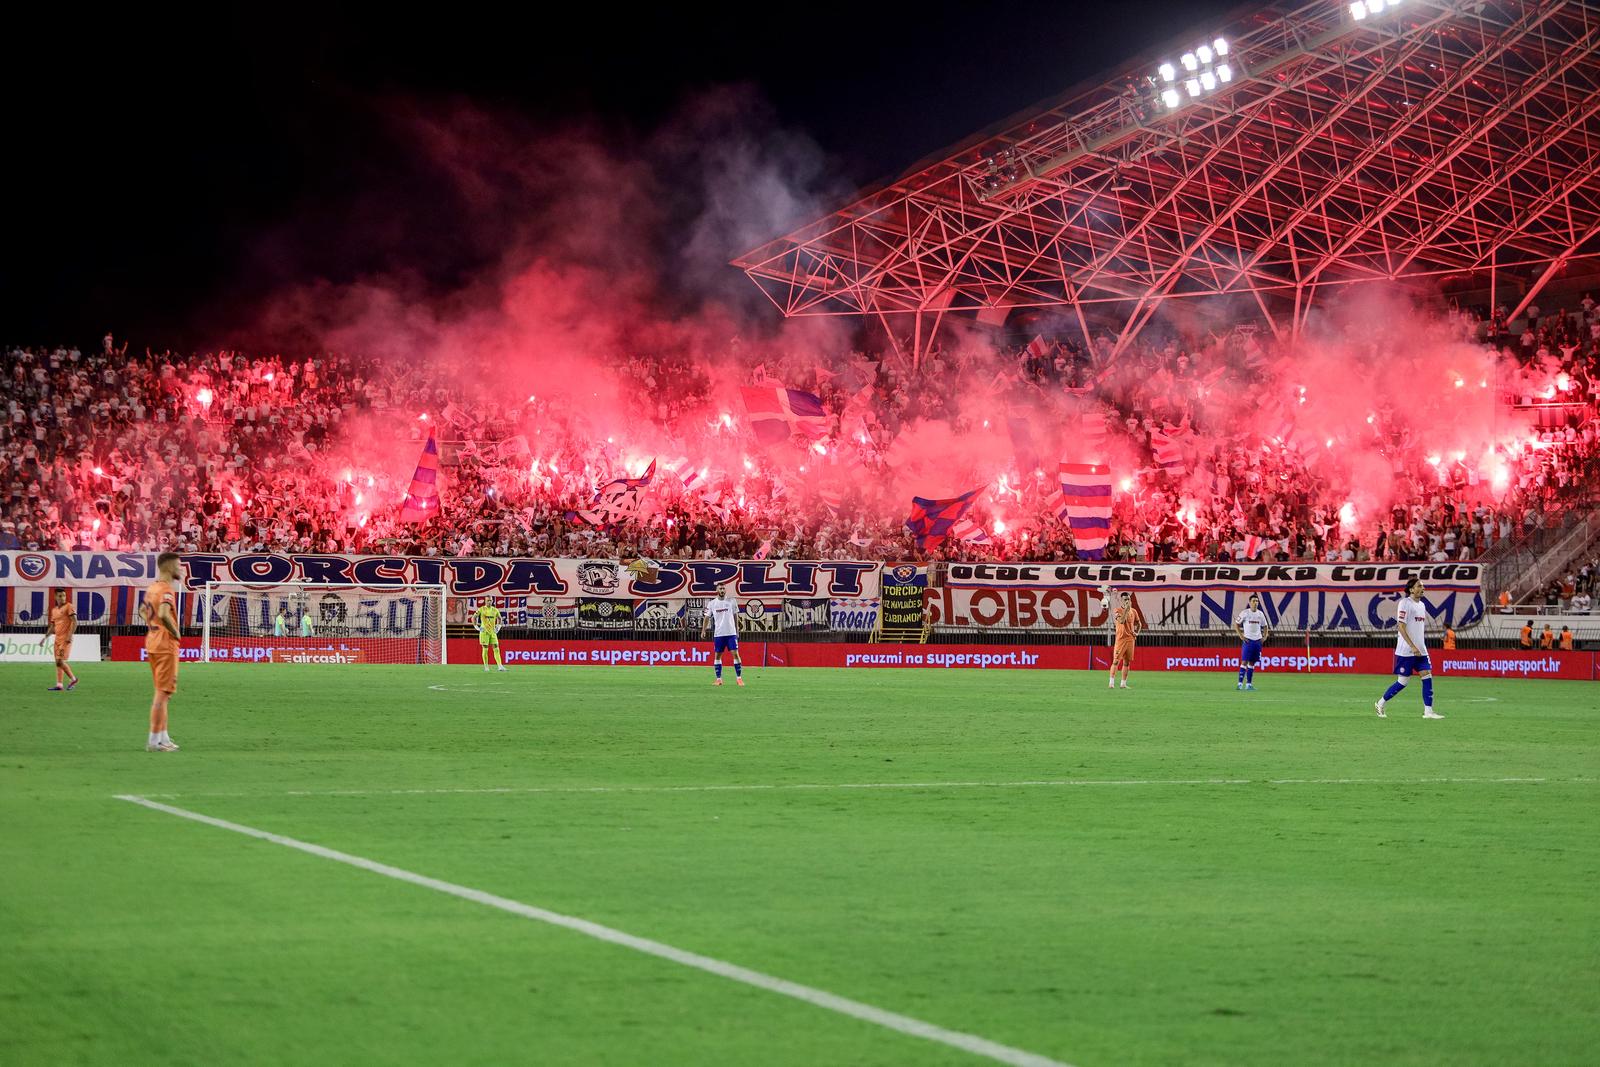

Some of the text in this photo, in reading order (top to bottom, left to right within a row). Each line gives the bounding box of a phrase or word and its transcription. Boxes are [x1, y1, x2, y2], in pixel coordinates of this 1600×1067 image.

[179, 554, 879, 597] TORCIDA SPLIT
[1181, 565, 1317, 582] majka
[883, 585, 923, 596] TORCIDA
[467, 611, 528, 625] ZREB
[831, 611, 877, 629] TROGIR
[293, 652, 347, 664] aircash
[505, 647, 710, 664] preuzmi na supersport.hr
[846, 650, 1039, 668] preuzmi na supersport.hr
[1166, 652, 1356, 670] preuzmi na persport.hr
[1442, 658, 1477, 672] preuzmi
[1478, 661, 1489, 670] na
[1490, 656, 1561, 676] supersport.hr
